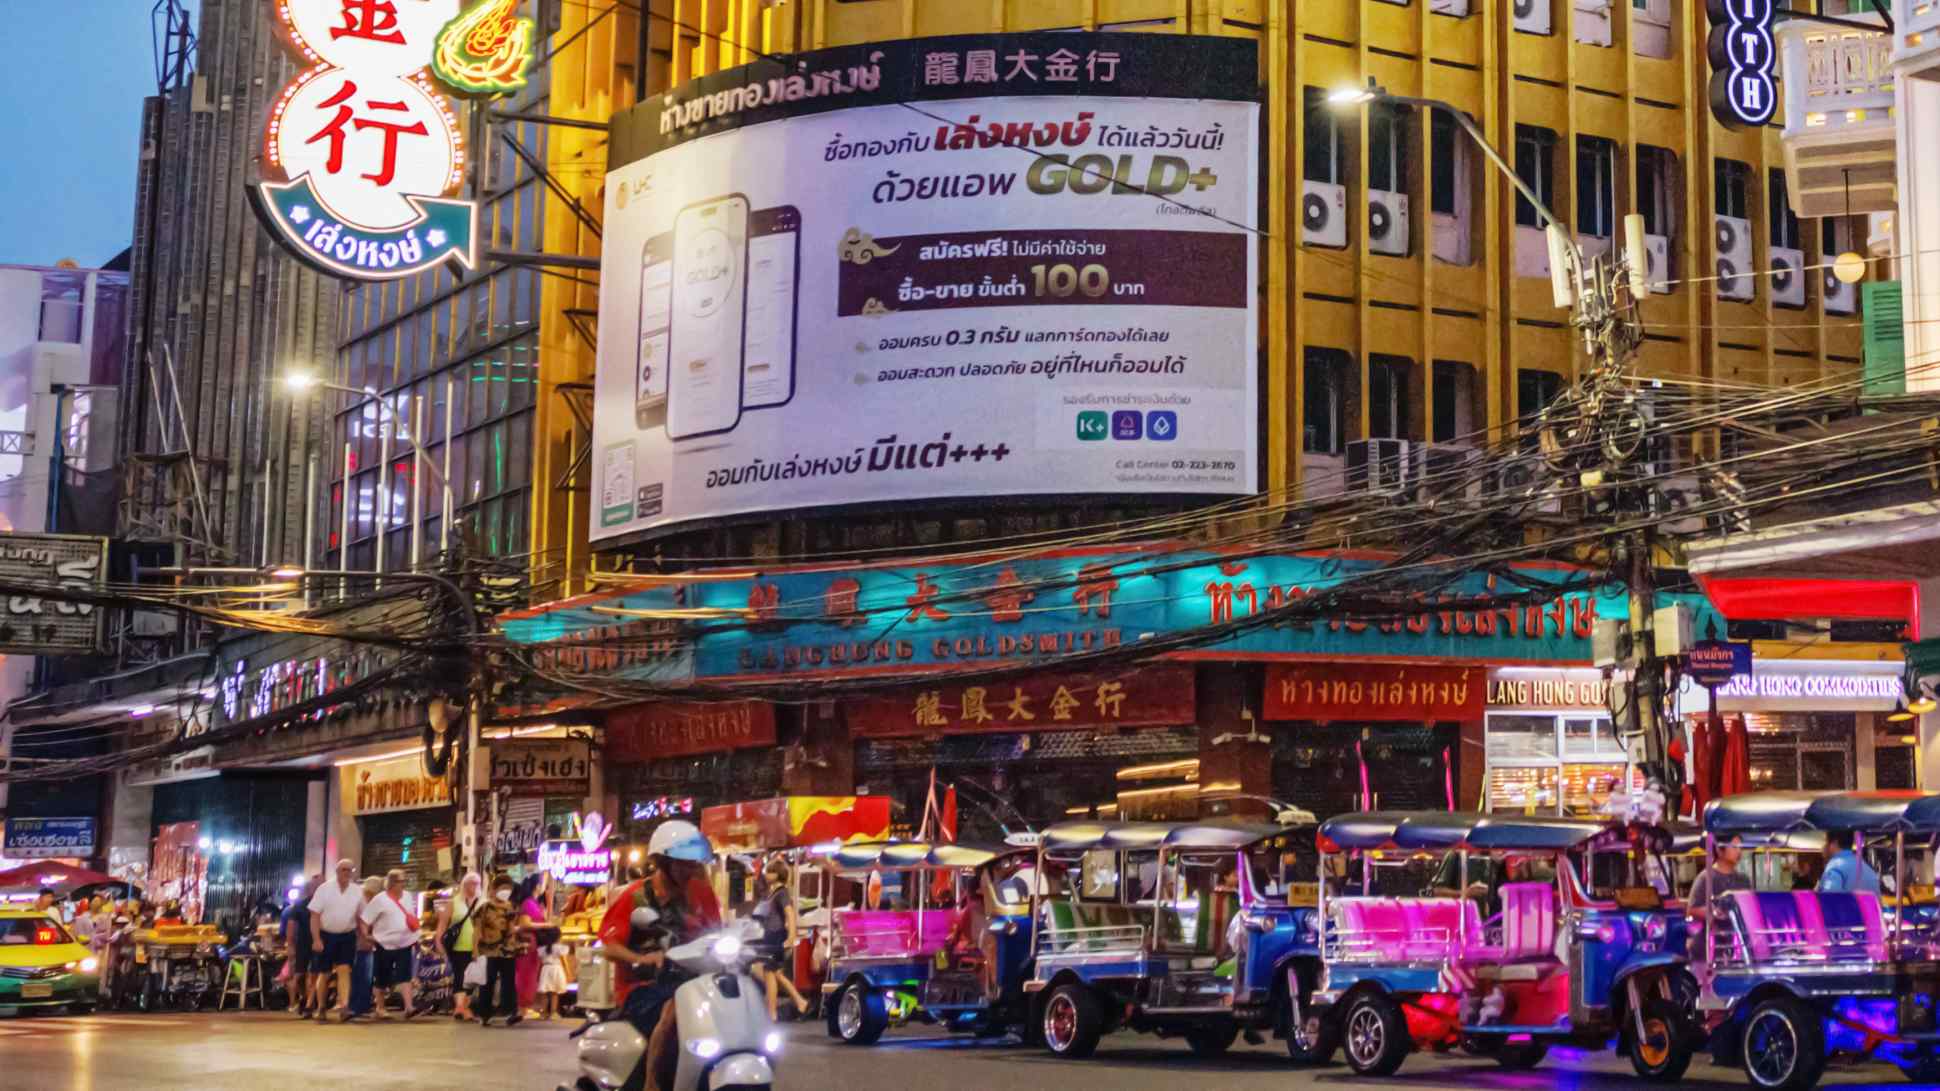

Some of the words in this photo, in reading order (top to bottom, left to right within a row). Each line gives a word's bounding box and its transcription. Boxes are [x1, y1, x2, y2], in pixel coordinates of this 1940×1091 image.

[924, 48, 1121, 86] 龍鳳大金行
[824, 131, 930, 162] ซื้อทองกับ
[934, 112, 1095, 151] เล่งหงษ์
[1097, 122, 1224, 150] ได้แล้ววันนี้!
[872, 169, 1016, 204] ด้วยแอพ
[1026, 153, 1218, 196] GOLD+
[303, 217, 423, 268] เล่งหงษ์
[919, 239, 1008, 261] สมัครฟรี!
[1012, 239, 1106, 257] ไม่มีค่าใช้จ่าย
[898, 276, 974, 302] ซื้อ-ขาย
[979, 274, 1026, 298] ขั้นต่ำ
[1031, 263, 1110, 298] 100
[1113, 282, 1145, 297] บาท
[878, 335, 942, 352] ออมครบ
[945, 329, 975, 347] 0.3
[979, 325, 1021, 345] กรัม
[1024, 326, 1170, 344] แลกการ์ดทองได้เลย
[877, 365, 955, 383] ออมสะดวก
[960, 360, 1026, 377] ปลอดภัย
[1030, 353, 1185, 379] อยู่ที่ไหนก็ออมได้
[706, 447, 864, 488] ออมกับเล่งหงษ์
[867, 432, 1010, 471] มีแต่+++
[932, 629, 1121, 658] GOLDSMITH
[911, 680, 1127, 726] 龍鳳大金行
[1487, 680, 1527, 704] LANG
[1533, 680, 1574, 704] HONG
[1580, 680, 1607, 705] GO
